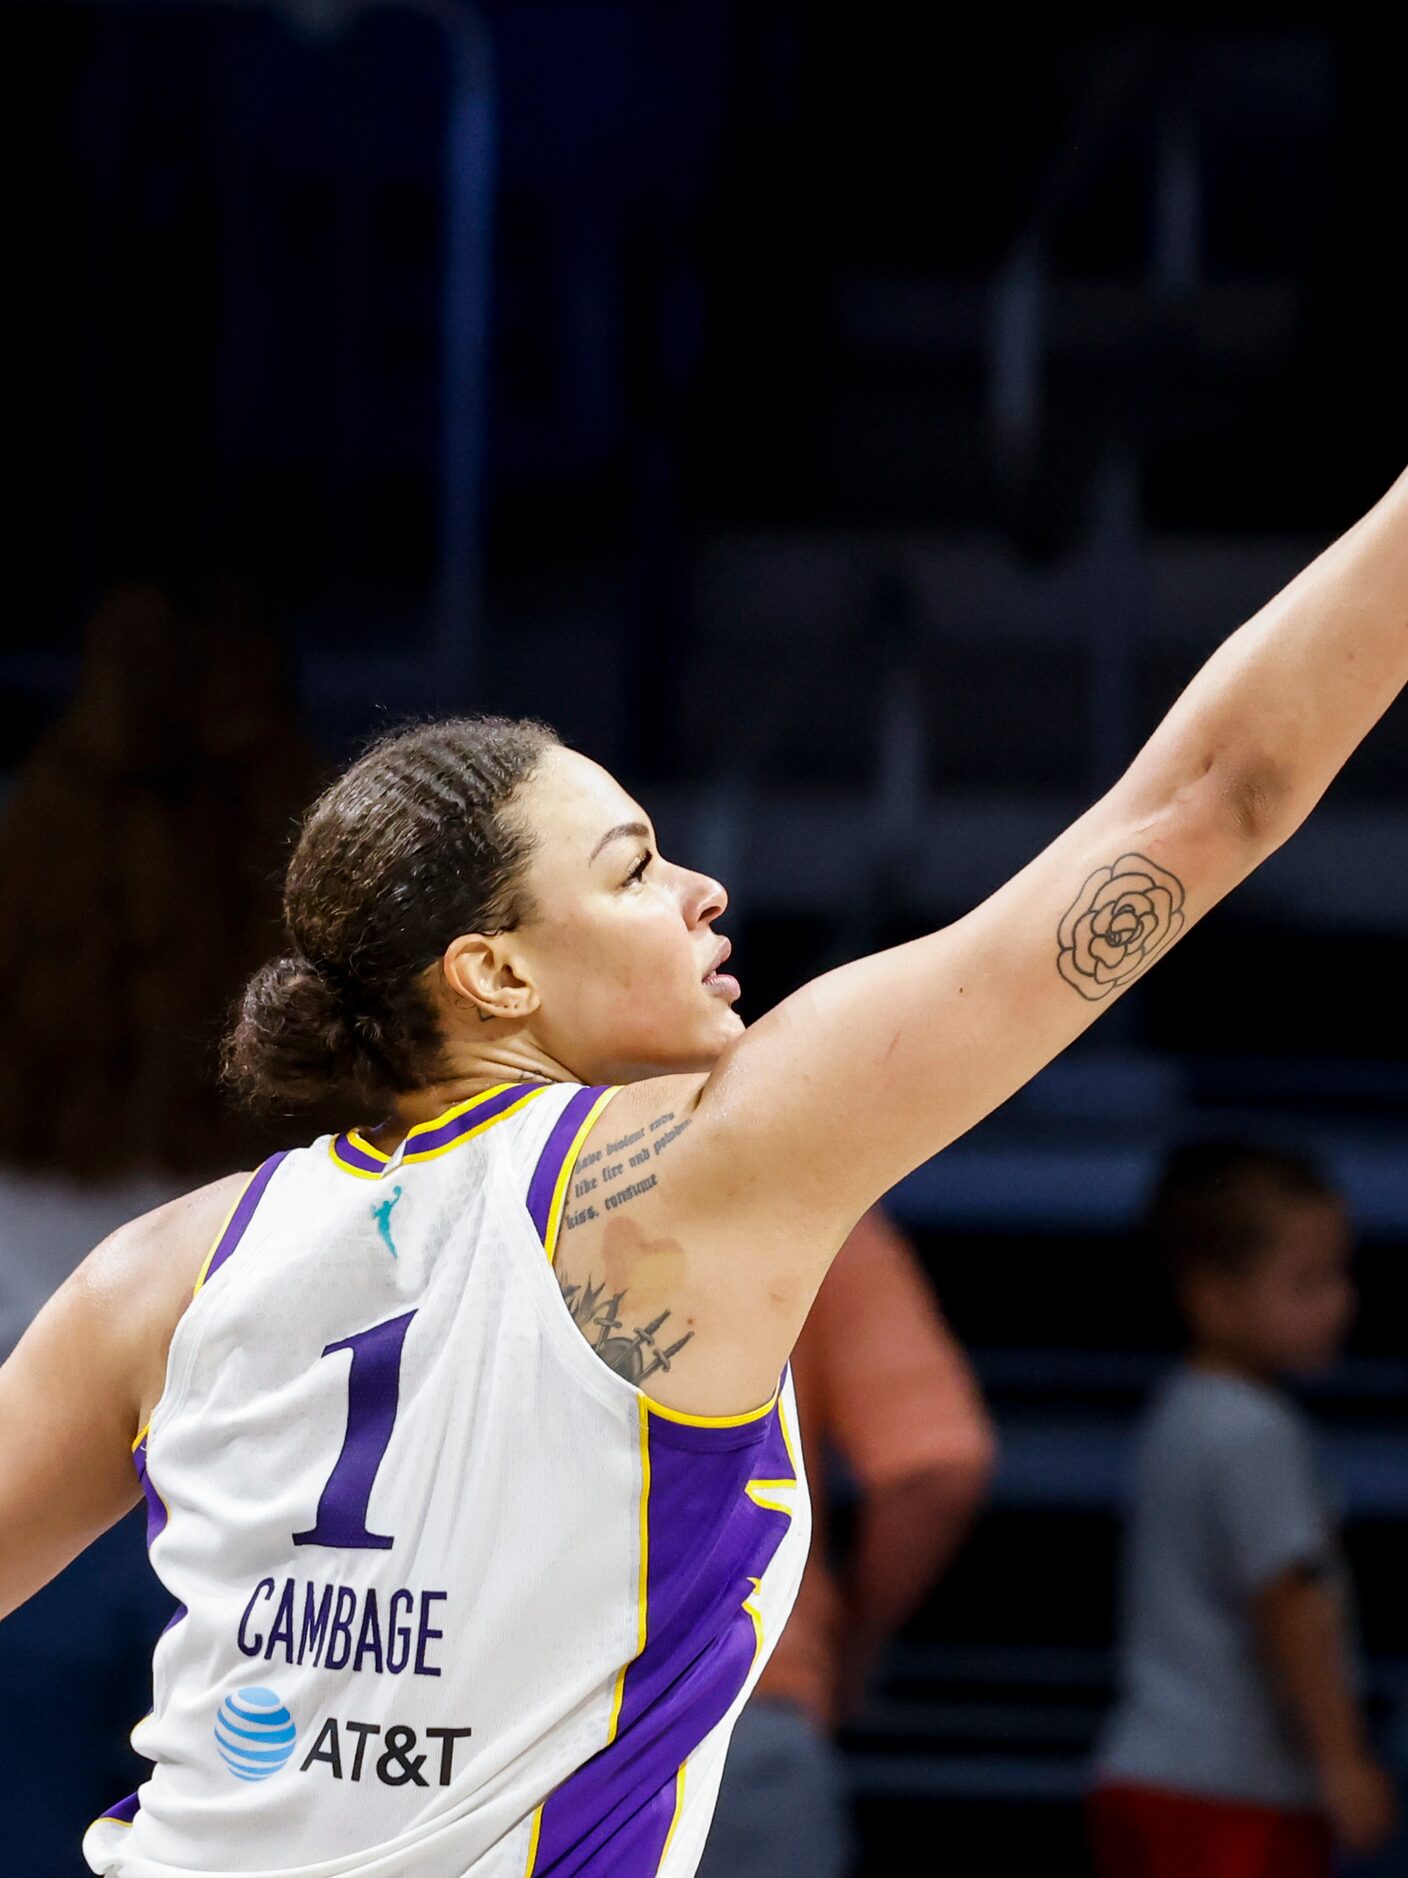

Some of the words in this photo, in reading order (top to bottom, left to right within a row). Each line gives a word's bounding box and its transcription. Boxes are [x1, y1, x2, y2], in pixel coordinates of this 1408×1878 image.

[604, 1174, 658, 1210] consume
[291, 1308, 419, 1550] 1
[237, 1577, 448, 1677] CAMBAGE
[299, 1717, 472, 1787] AT&T
